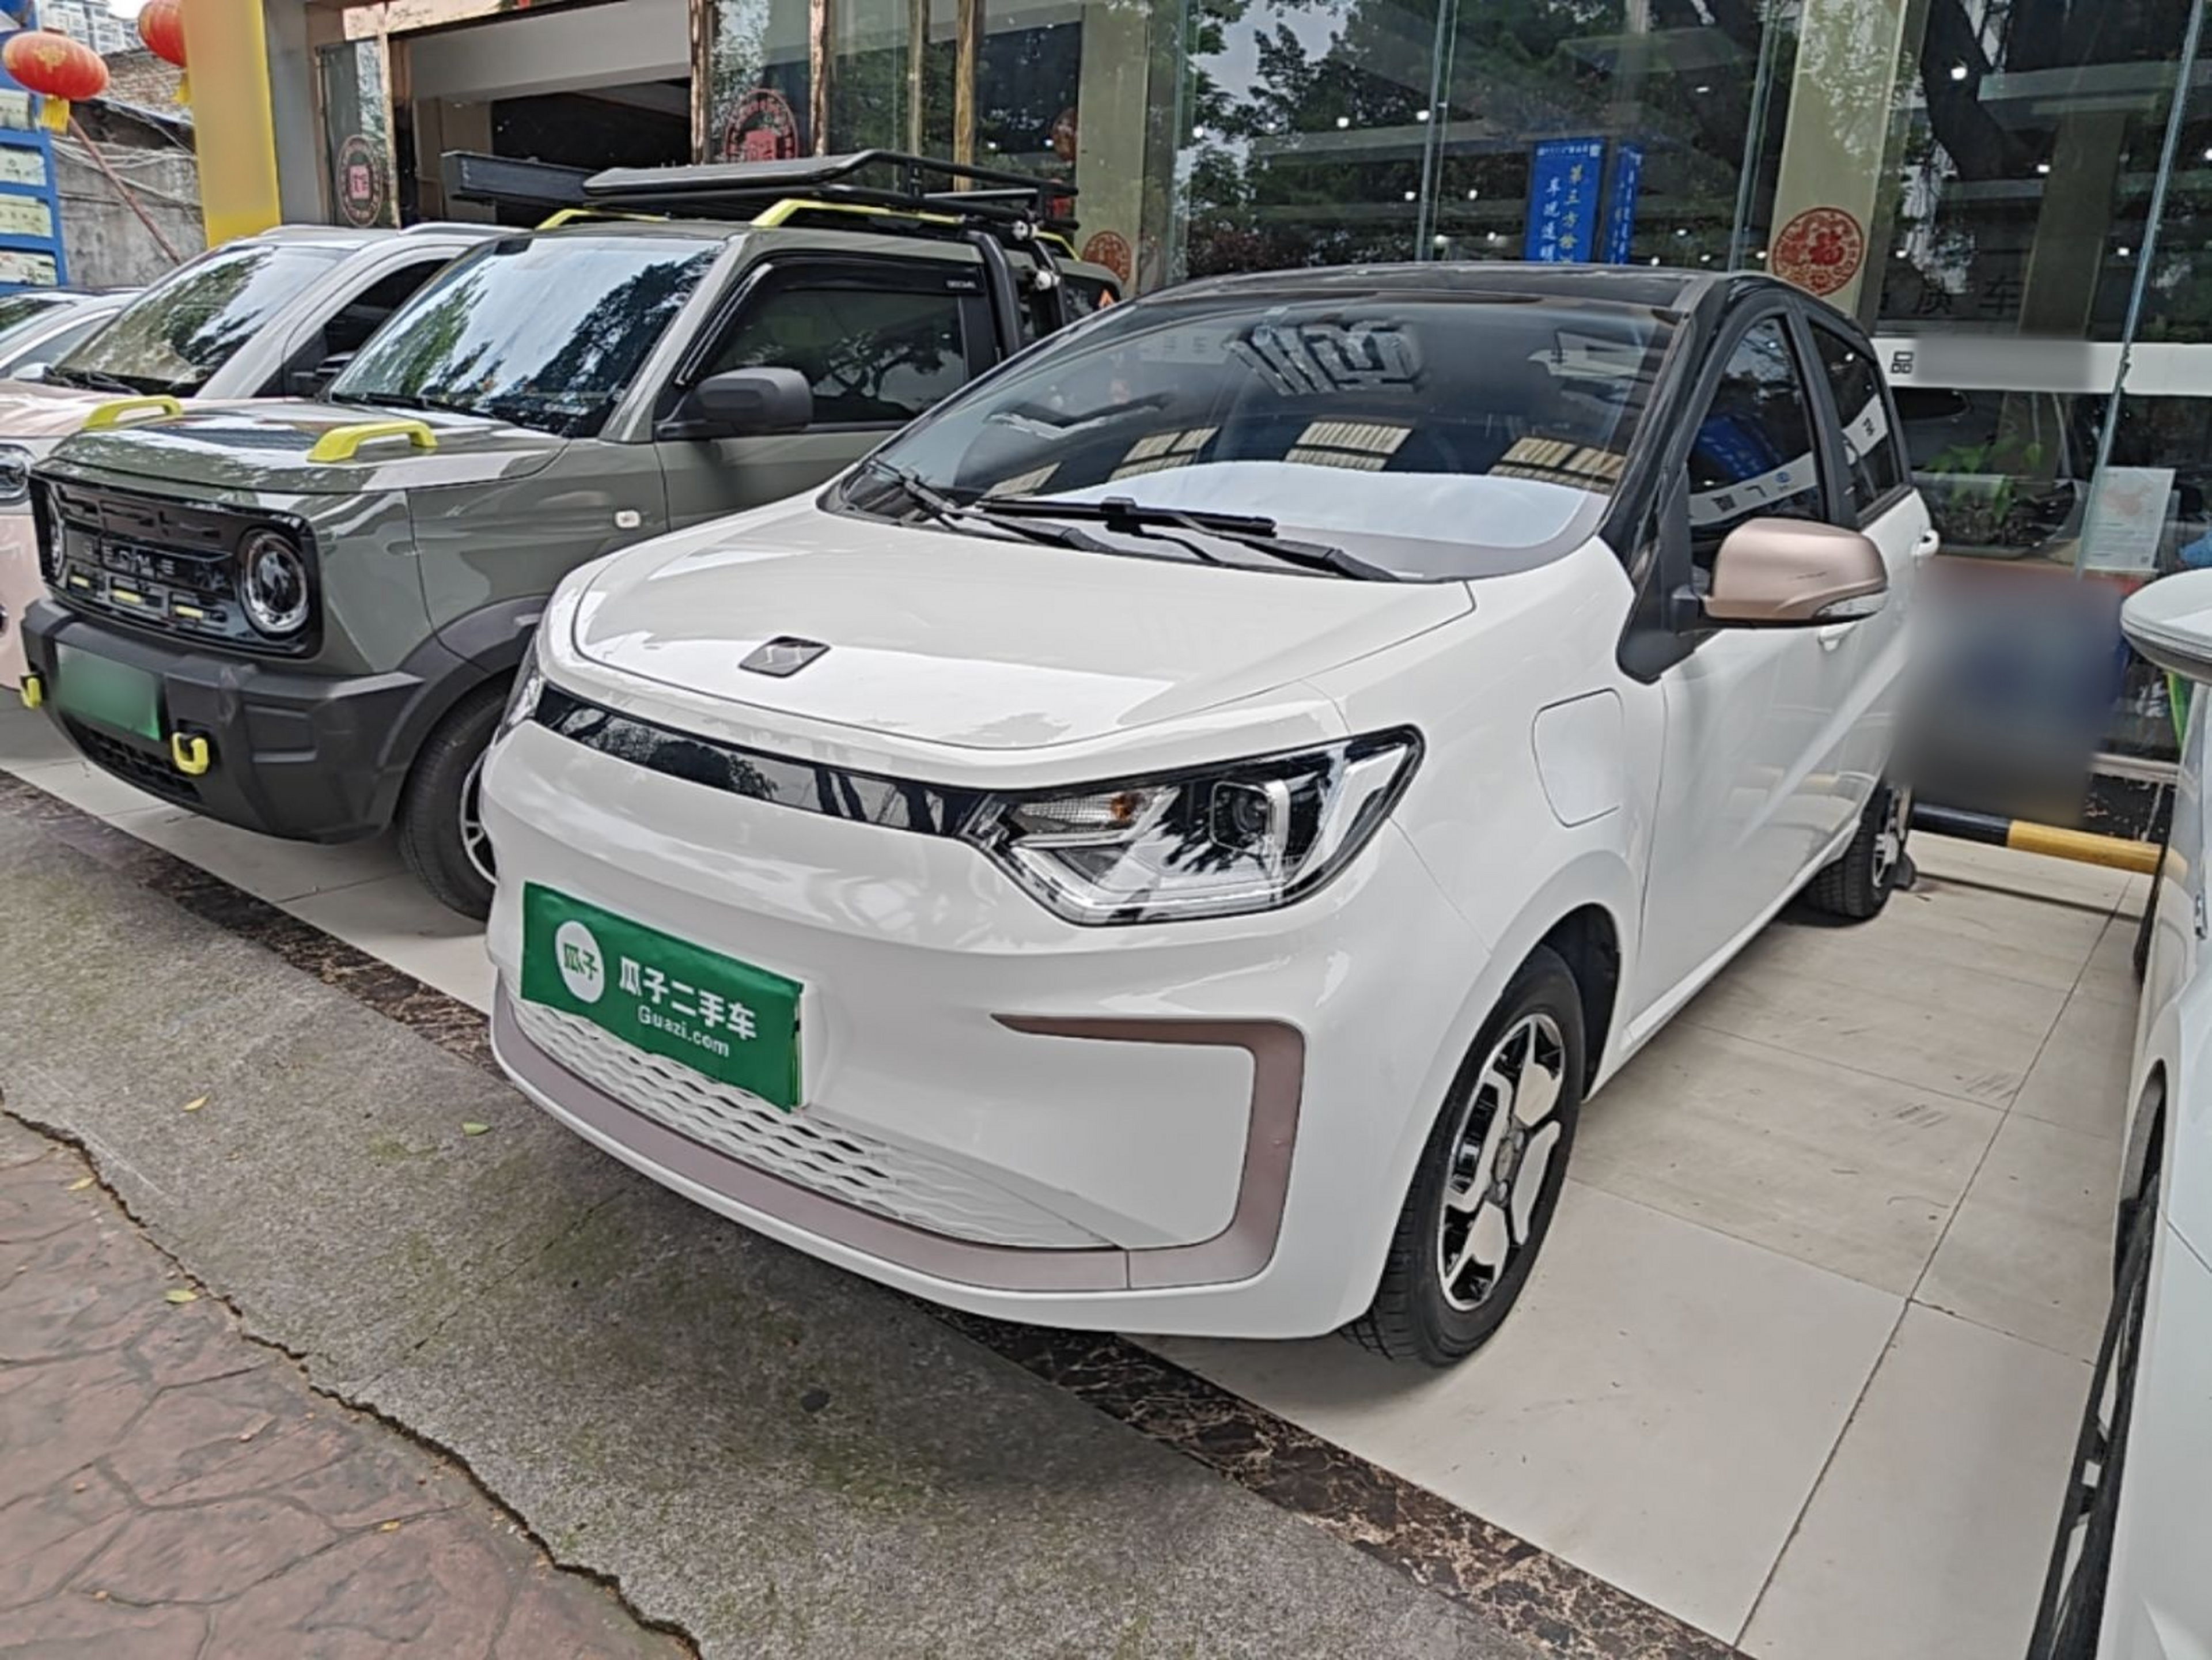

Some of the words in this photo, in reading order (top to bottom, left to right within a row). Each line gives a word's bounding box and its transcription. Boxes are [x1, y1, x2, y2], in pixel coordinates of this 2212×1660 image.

[563, 941, 599, 981] 瓜子
[619, 955, 757, 1040] 瓜子二手车
[637, 1004, 730, 1058] Guazi.com
